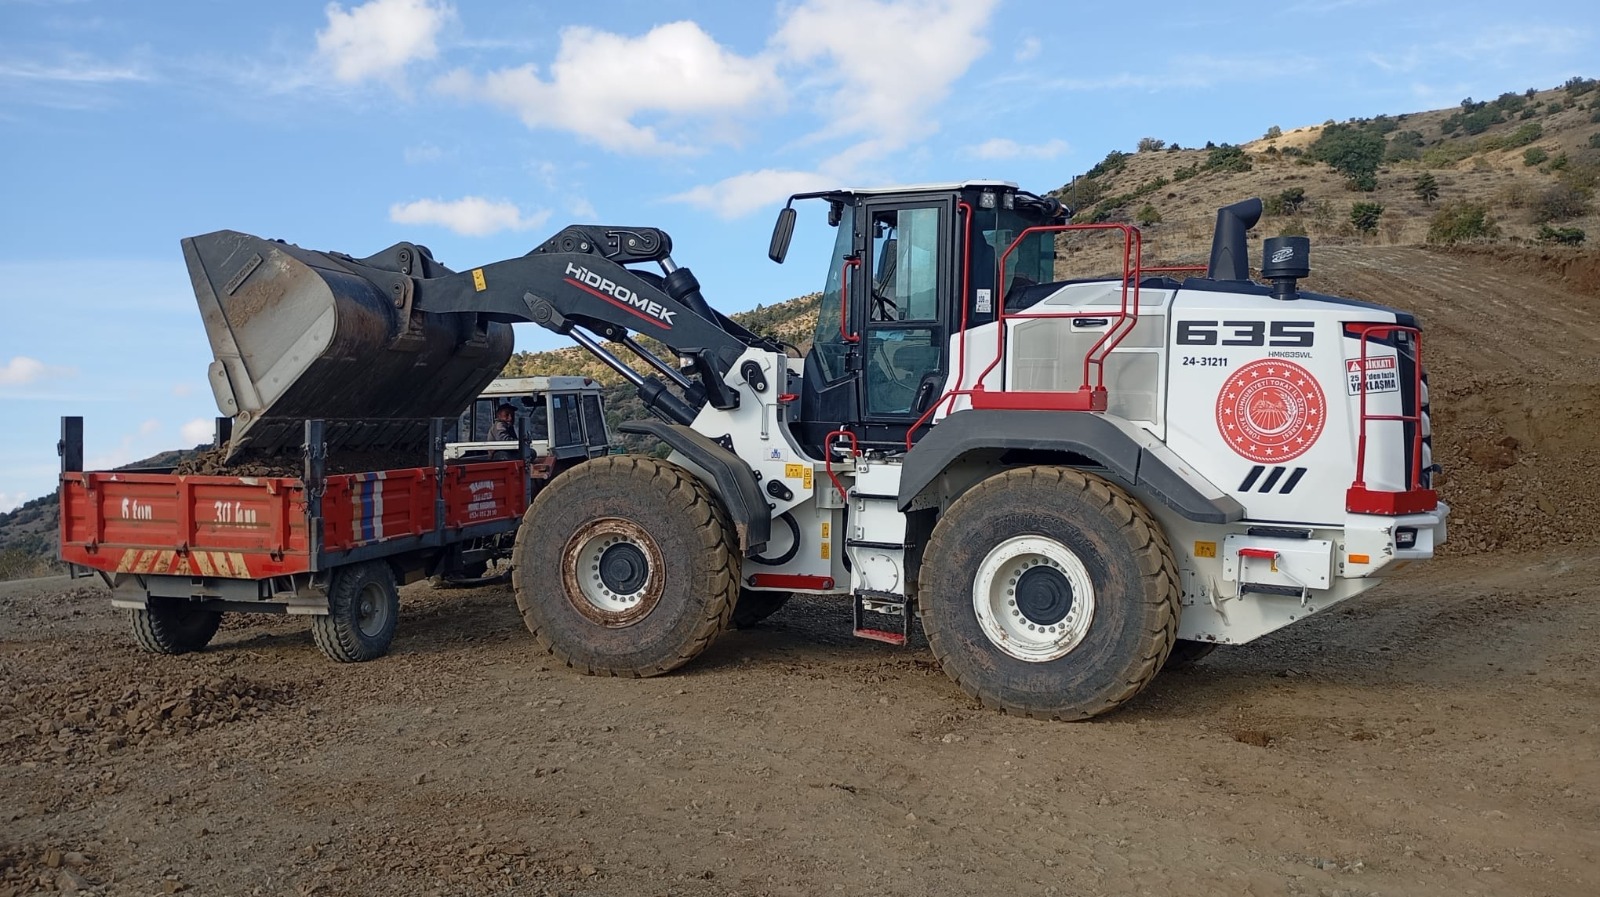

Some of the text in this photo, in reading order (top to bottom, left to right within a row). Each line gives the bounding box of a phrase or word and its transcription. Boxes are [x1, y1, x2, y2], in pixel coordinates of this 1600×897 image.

[1176, 320, 1315, 347] 635
[1268, 351, 1313, 359] HMK635WL
[1182, 356, 1228, 367] 24-31211
[1381, 371, 1395, 379] fazla
[1270, 380, 1293, 391] TOKAT
[1351, 379, 1396, 392] YAKLAŞMA
[121, 498, 152, 520] 6 ton
[213, 501, 232, 526] 30
